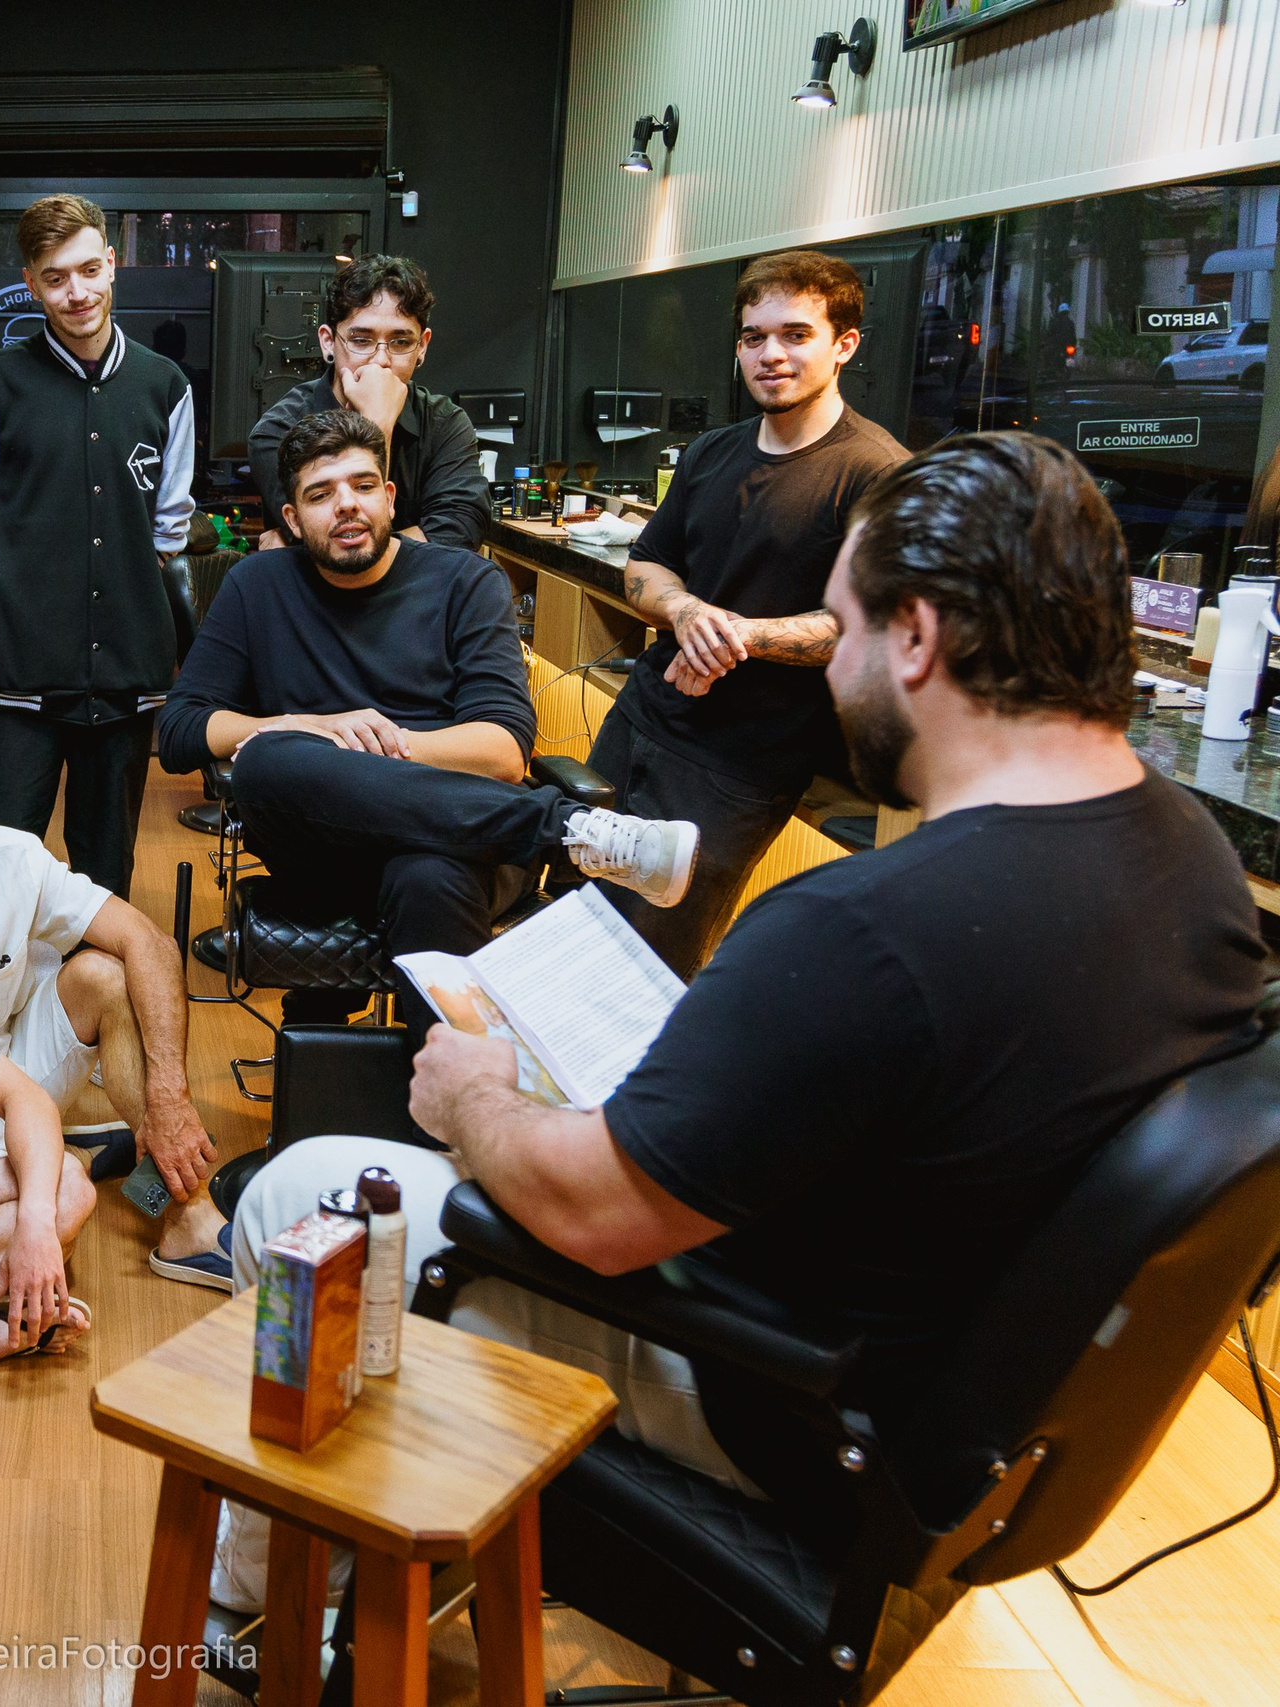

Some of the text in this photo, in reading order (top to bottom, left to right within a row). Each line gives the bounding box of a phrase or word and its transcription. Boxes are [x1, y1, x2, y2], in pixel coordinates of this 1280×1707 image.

[1120, 422, 1160, 433] ENTRE
[1082, 433, 1193, 447] AR CONDICIONADO
